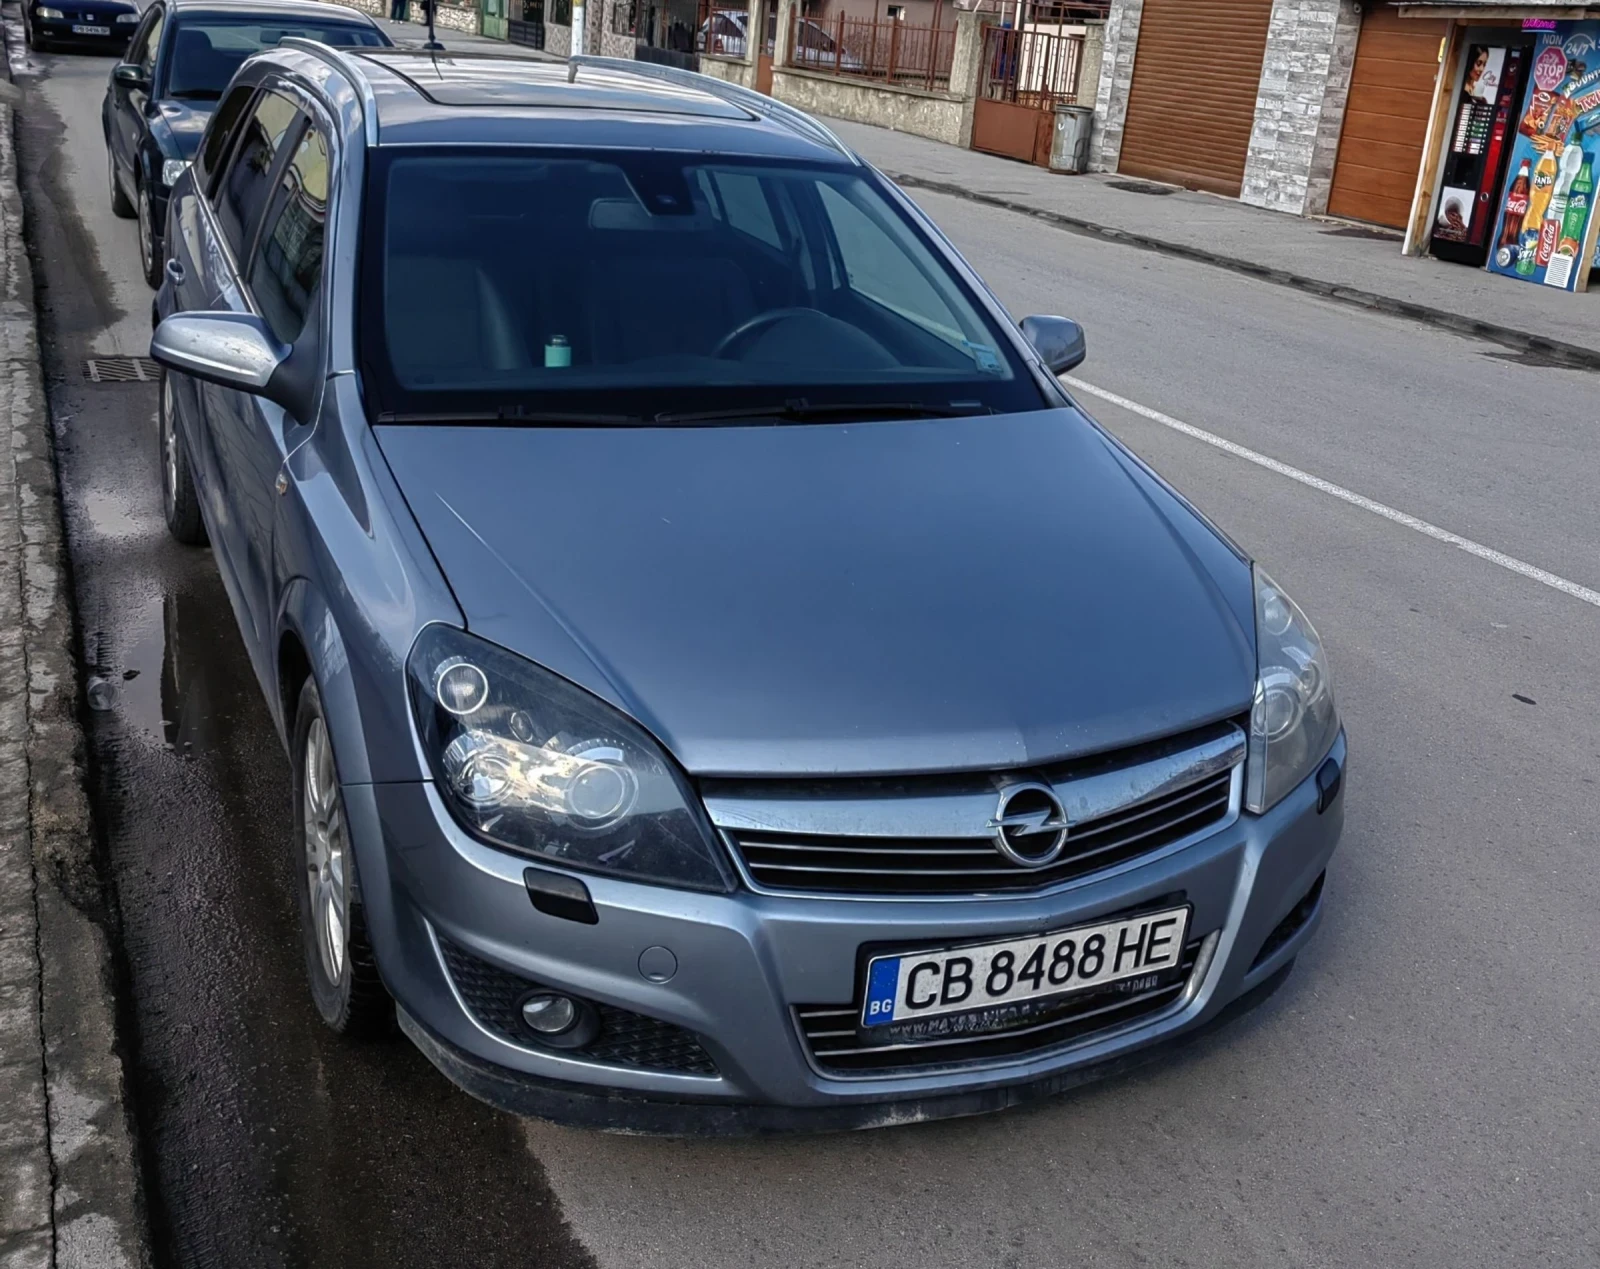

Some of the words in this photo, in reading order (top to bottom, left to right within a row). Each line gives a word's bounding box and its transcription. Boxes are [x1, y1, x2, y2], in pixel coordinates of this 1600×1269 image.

[1542, 33, 1563, 45] NON
[1566, 43, 1589, 57] 24/7
[1536, 63, 1564, 77] STOP
[1569, 69, 1600, 91] BOUNT
[905, 957, 973, 1009] CB
[985, 933, 1107, 997] 8488
[1113, 918, 1177, 974] HE
[869, 999, 893, 1016] BG
